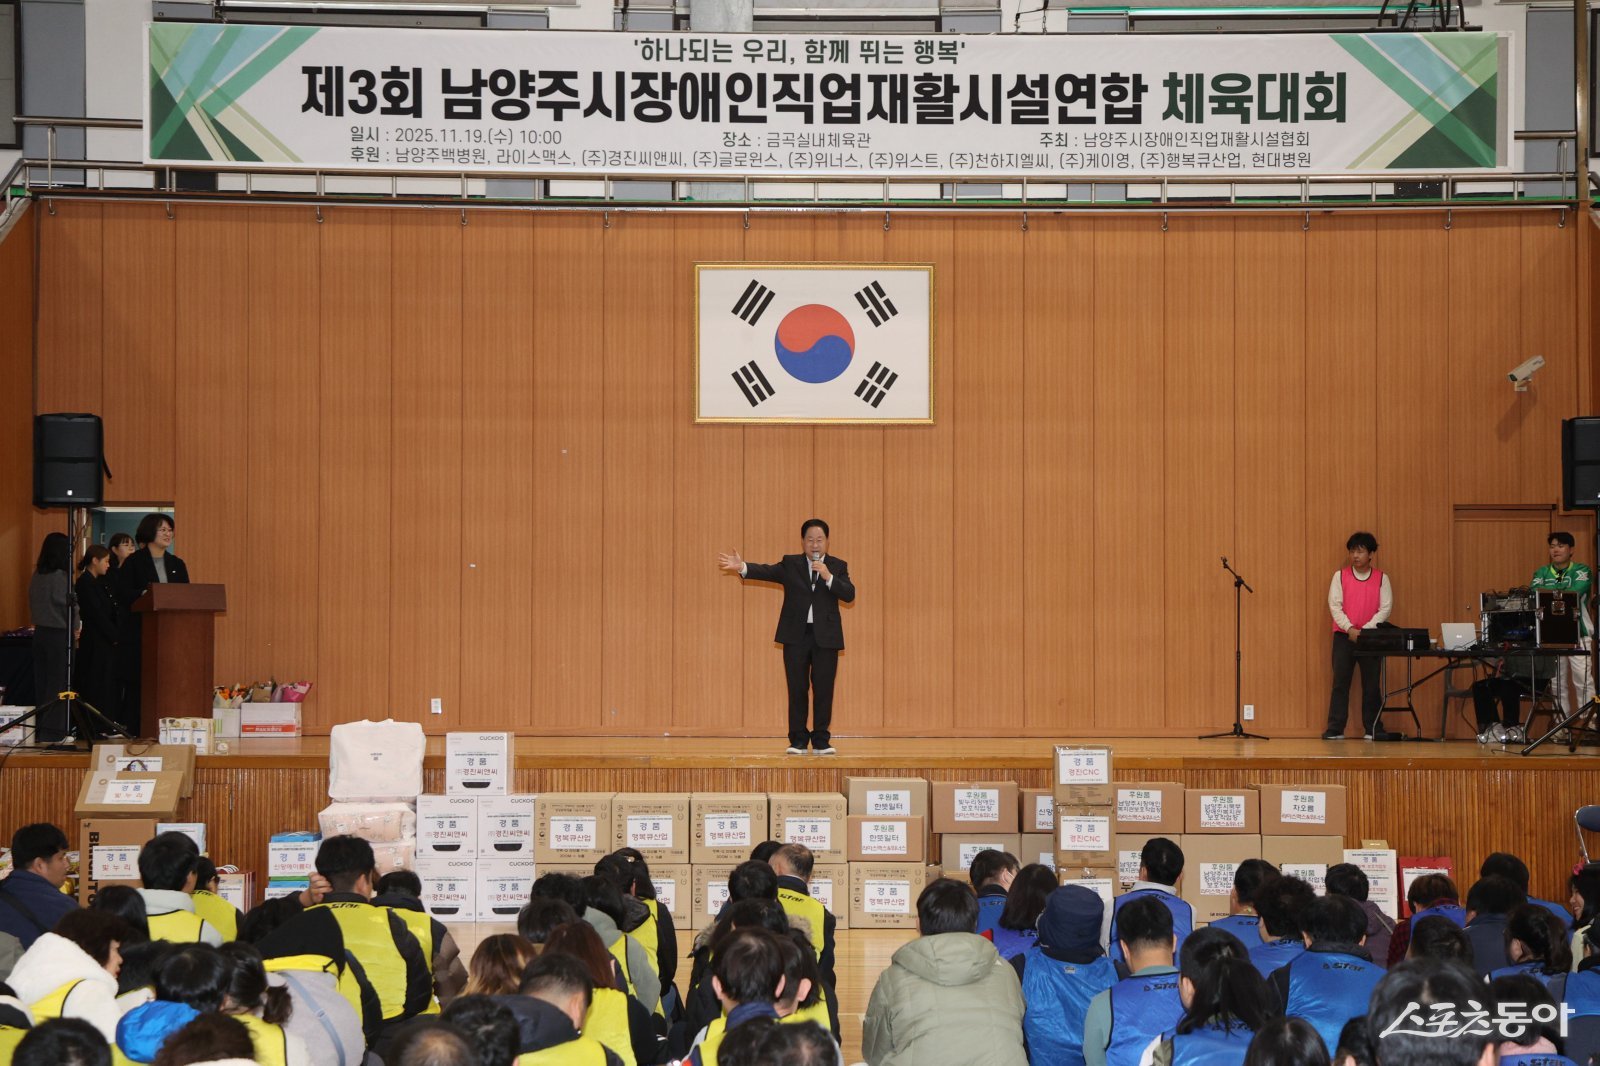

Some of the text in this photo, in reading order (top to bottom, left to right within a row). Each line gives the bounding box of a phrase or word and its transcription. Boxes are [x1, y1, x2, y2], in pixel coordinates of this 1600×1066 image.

[634, 38, 966, 65] '하나되는 우리, 함께 뛰는 행복'
[302, 66, 1347, 125] 제3회 남양주시장애인직업재활시설연합 체육대회
[350, 126, 379, 143] 일시
[395, 128, 513, 145] 2025.11.19.(수)
[519, 130, 562, 144] 10:00
[722, 132, 751, 148] 장소
[766, 132, 871, 149] 금곡실내체육관
[1040, 132, 1068, 148] 주최
[1084, 131, 1310, 148] 남양주시장애인직업재활시설협회
[350, 146, 380, 163] 후원
[396, 148, 490, 165] 남양주백병원,
[497, 149, 576, 167] 라이스맥스,
[582, 150, 686, 168] (주)경진씨앤씨,
[693, 151, 782, 169] (주)글로윈스,
[788, 152, 863, 170] (주)위너스,
[868, 152, 943, 170] (주)위스트,
[949, 152, 1054, 170] (주)천하지엘씨,
[1059, 152, 1134, 169] (주)케이영,
[1140, 152, 1246, 169] (주)행복큐산업,
[1252, 152, 1311, 169] 현대병원
